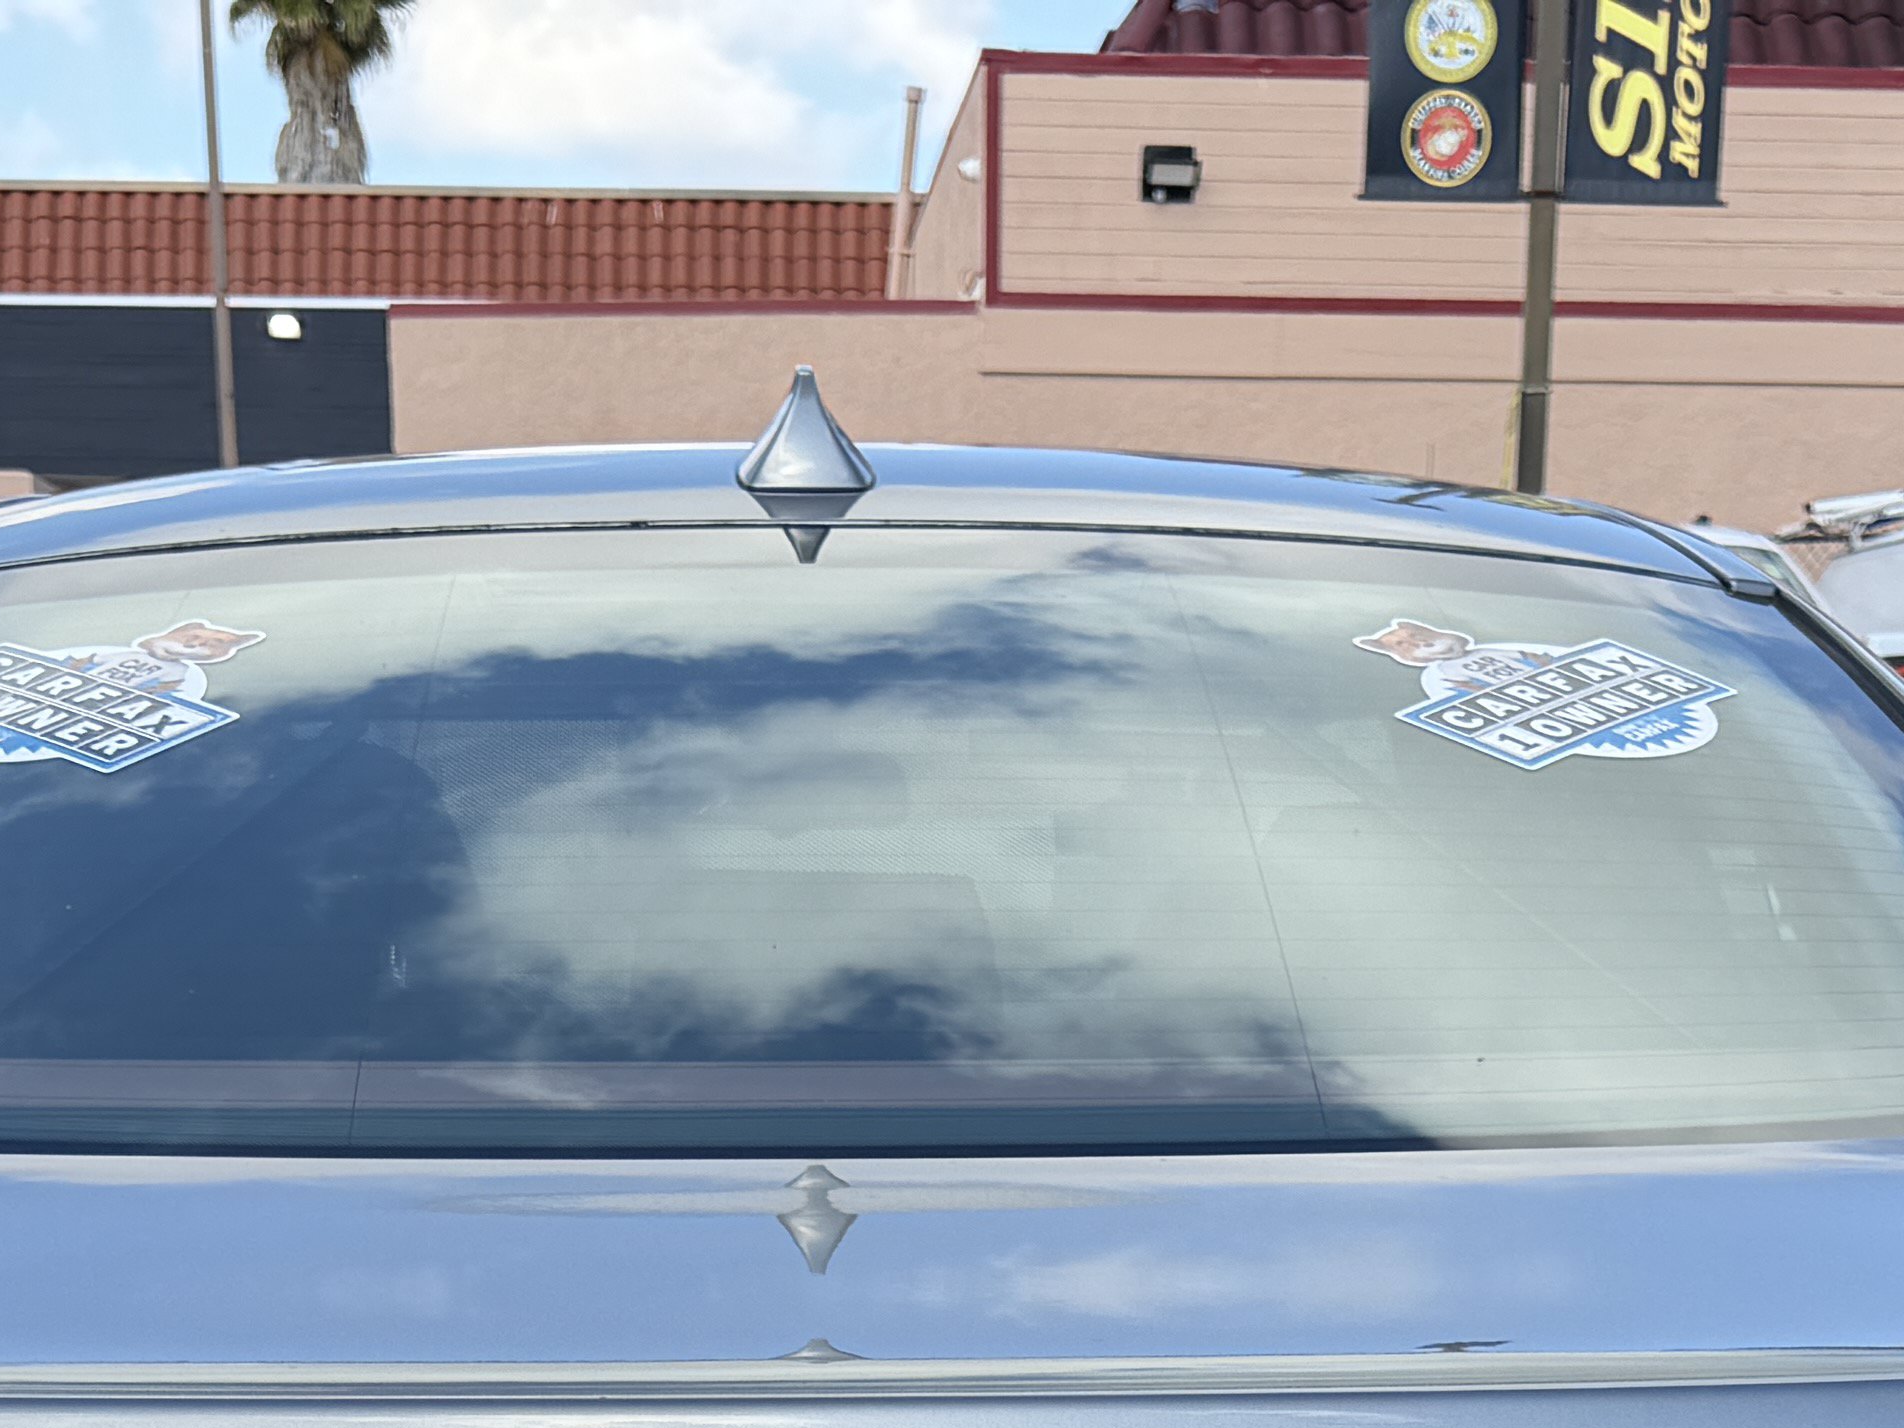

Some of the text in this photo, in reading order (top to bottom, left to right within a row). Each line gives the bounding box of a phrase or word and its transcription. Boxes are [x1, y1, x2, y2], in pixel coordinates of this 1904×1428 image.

[1441, 655, 1650, 729] CARFAX
[1497, 732, 1543, 752] 1
[1529, 672, 1699, 739] OWNER
